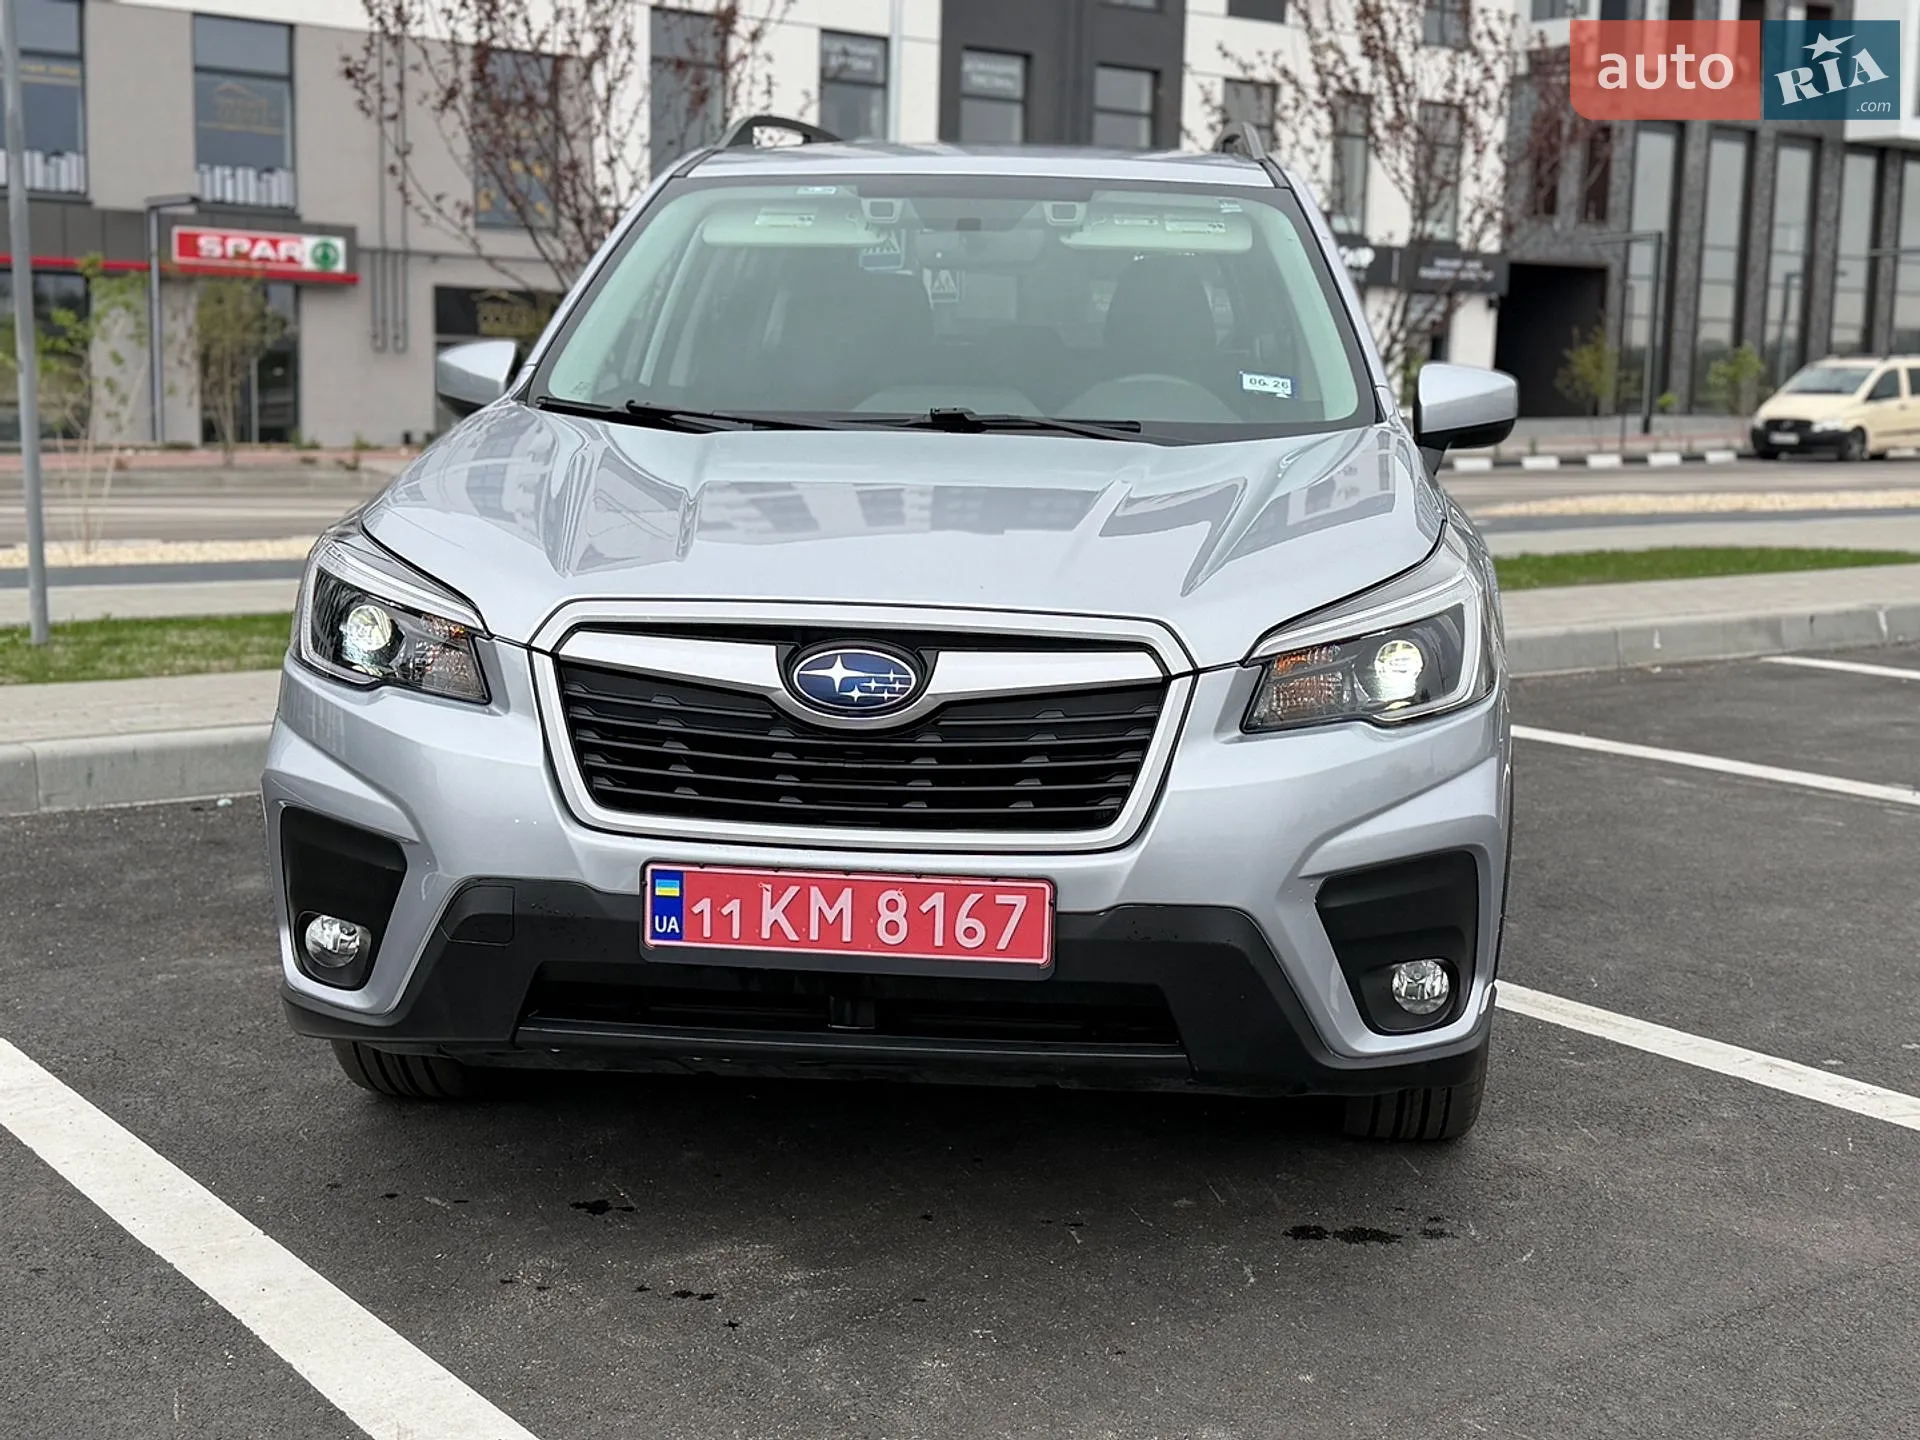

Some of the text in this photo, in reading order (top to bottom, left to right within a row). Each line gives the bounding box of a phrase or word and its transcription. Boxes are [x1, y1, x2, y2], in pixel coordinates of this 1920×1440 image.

[197, 235, 304, 264] SPAR
[655, 915, 680, 934] UA
[690, 883, 1028, 950] 11 KM 8167
